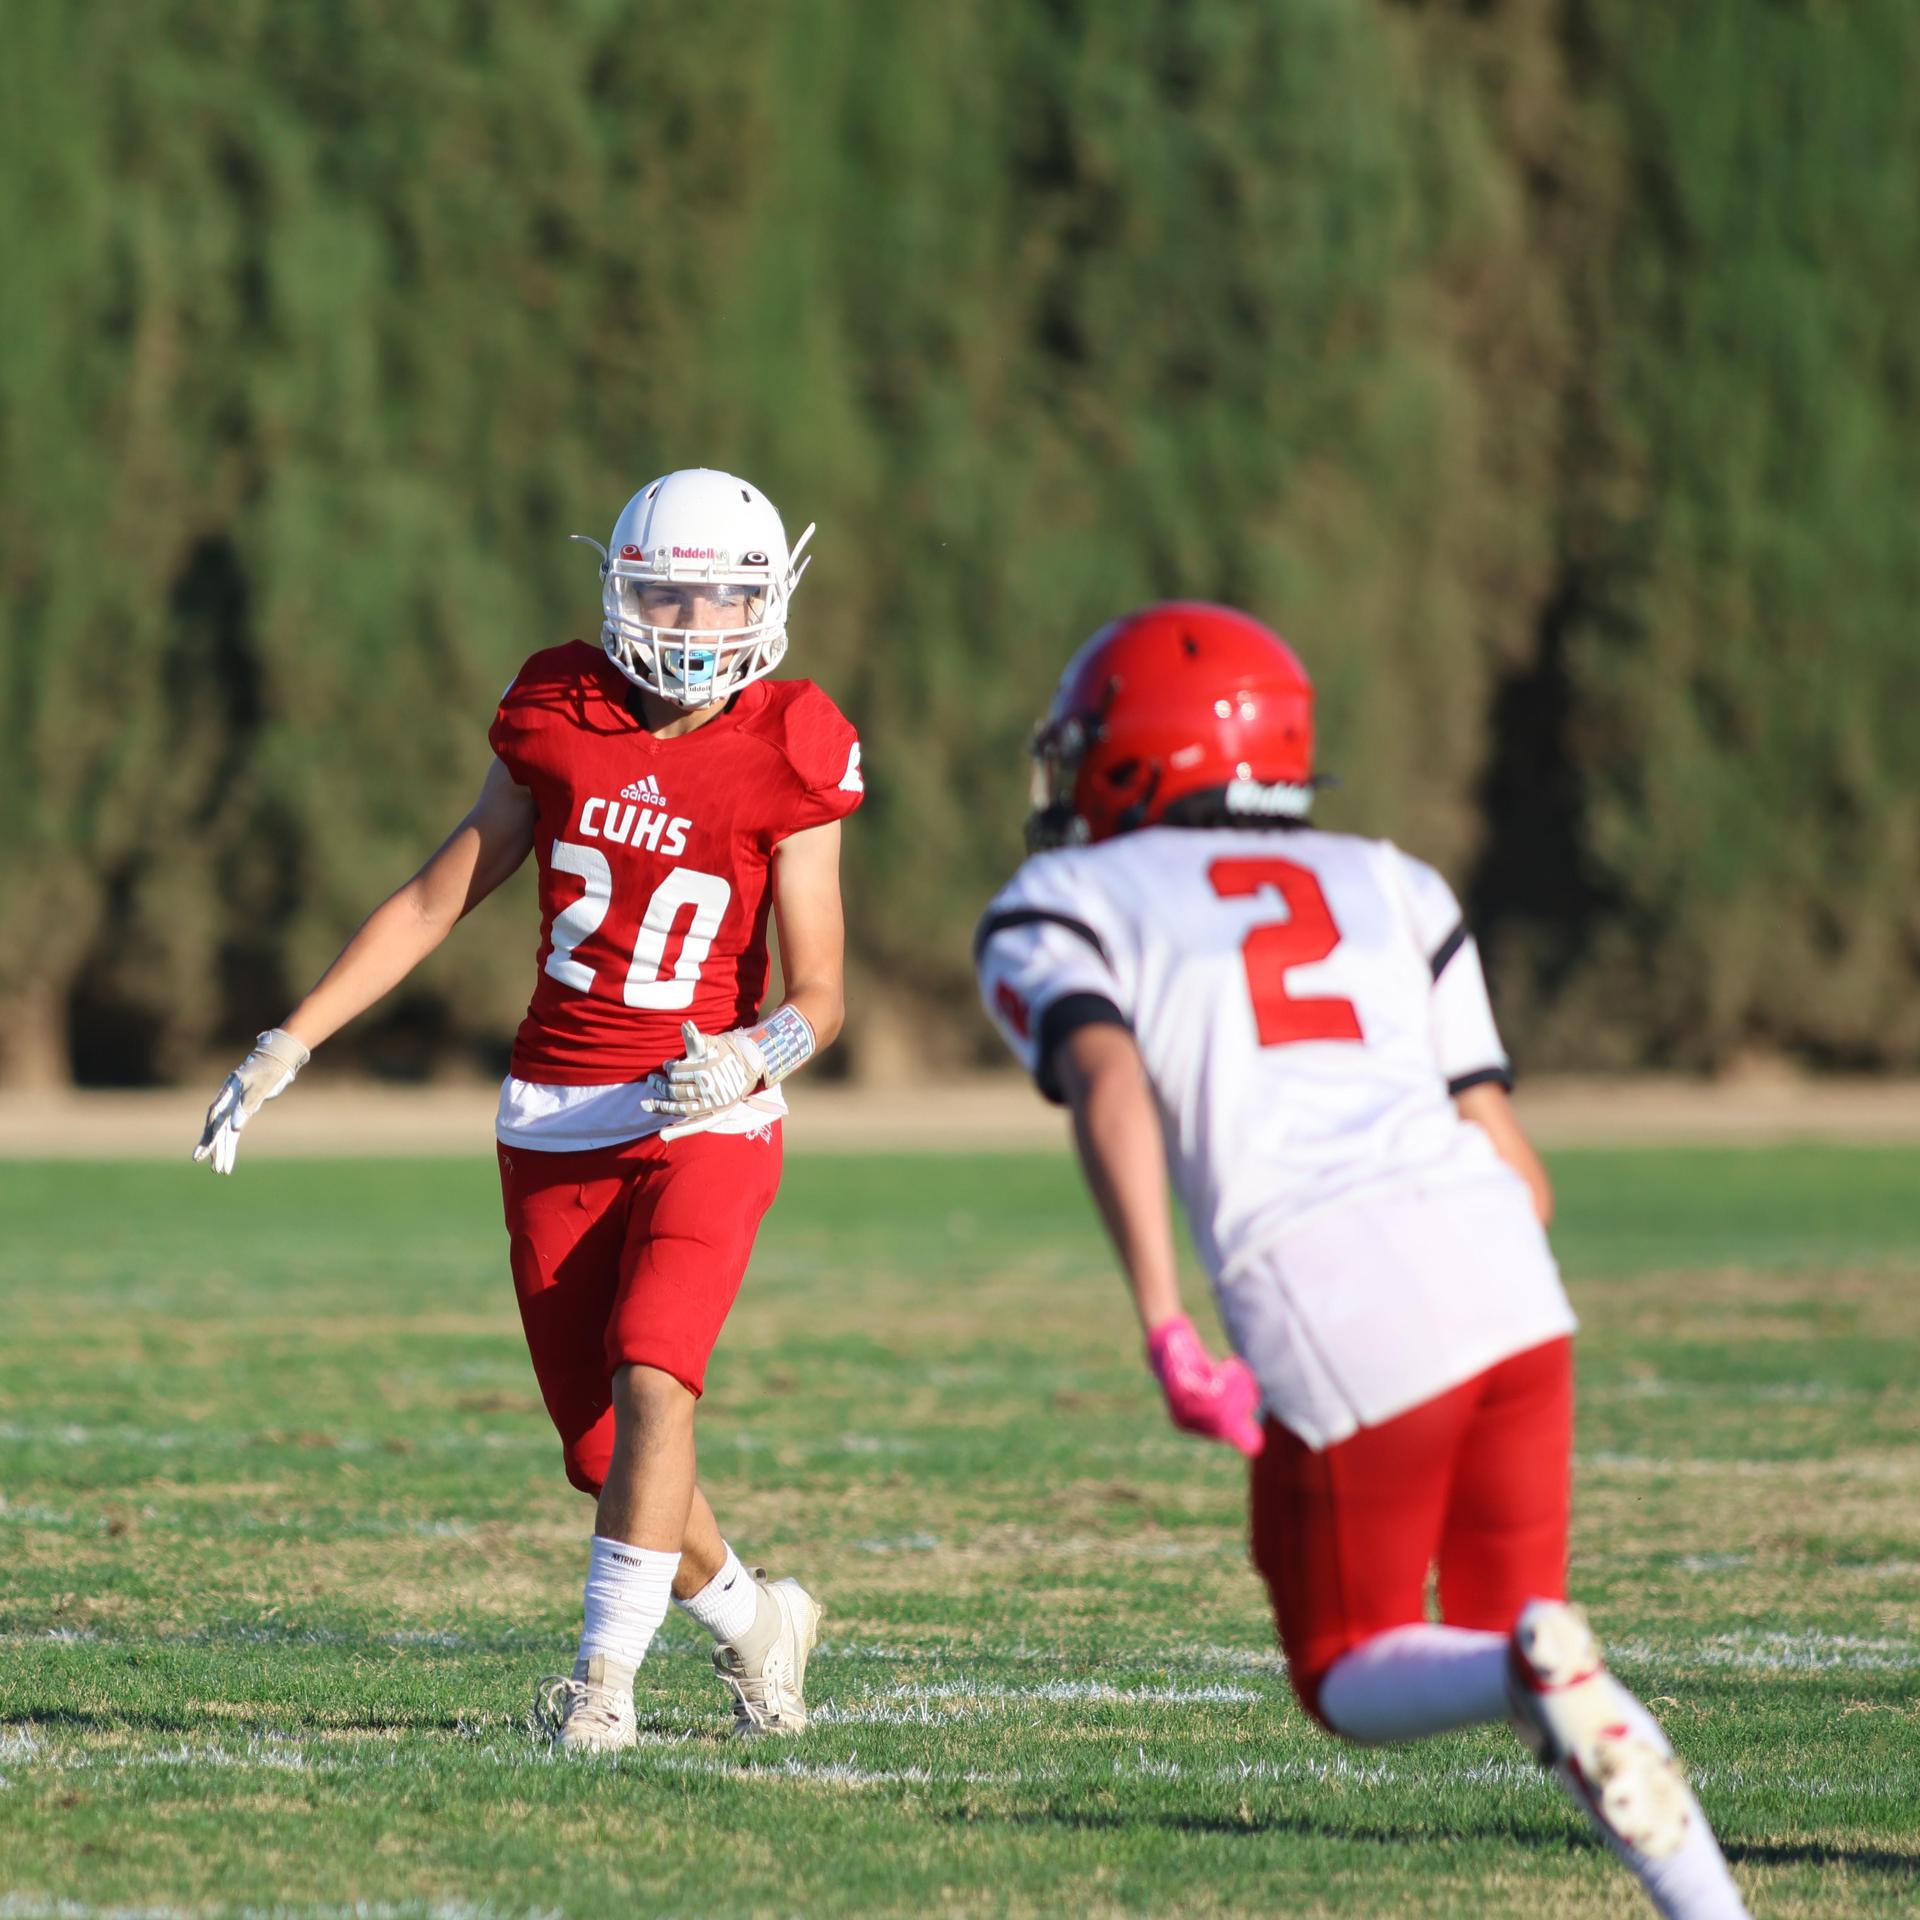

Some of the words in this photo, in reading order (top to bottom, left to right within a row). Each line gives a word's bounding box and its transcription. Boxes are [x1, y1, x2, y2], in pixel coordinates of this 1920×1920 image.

[672, 546, 714, 559] Riddell
[579, 797, 693, 856] CUHS
[620, 788, 667, 807] adidas
[544, 838, 731, 1010] 20
[1208, 858, 1364, 1047] 2
